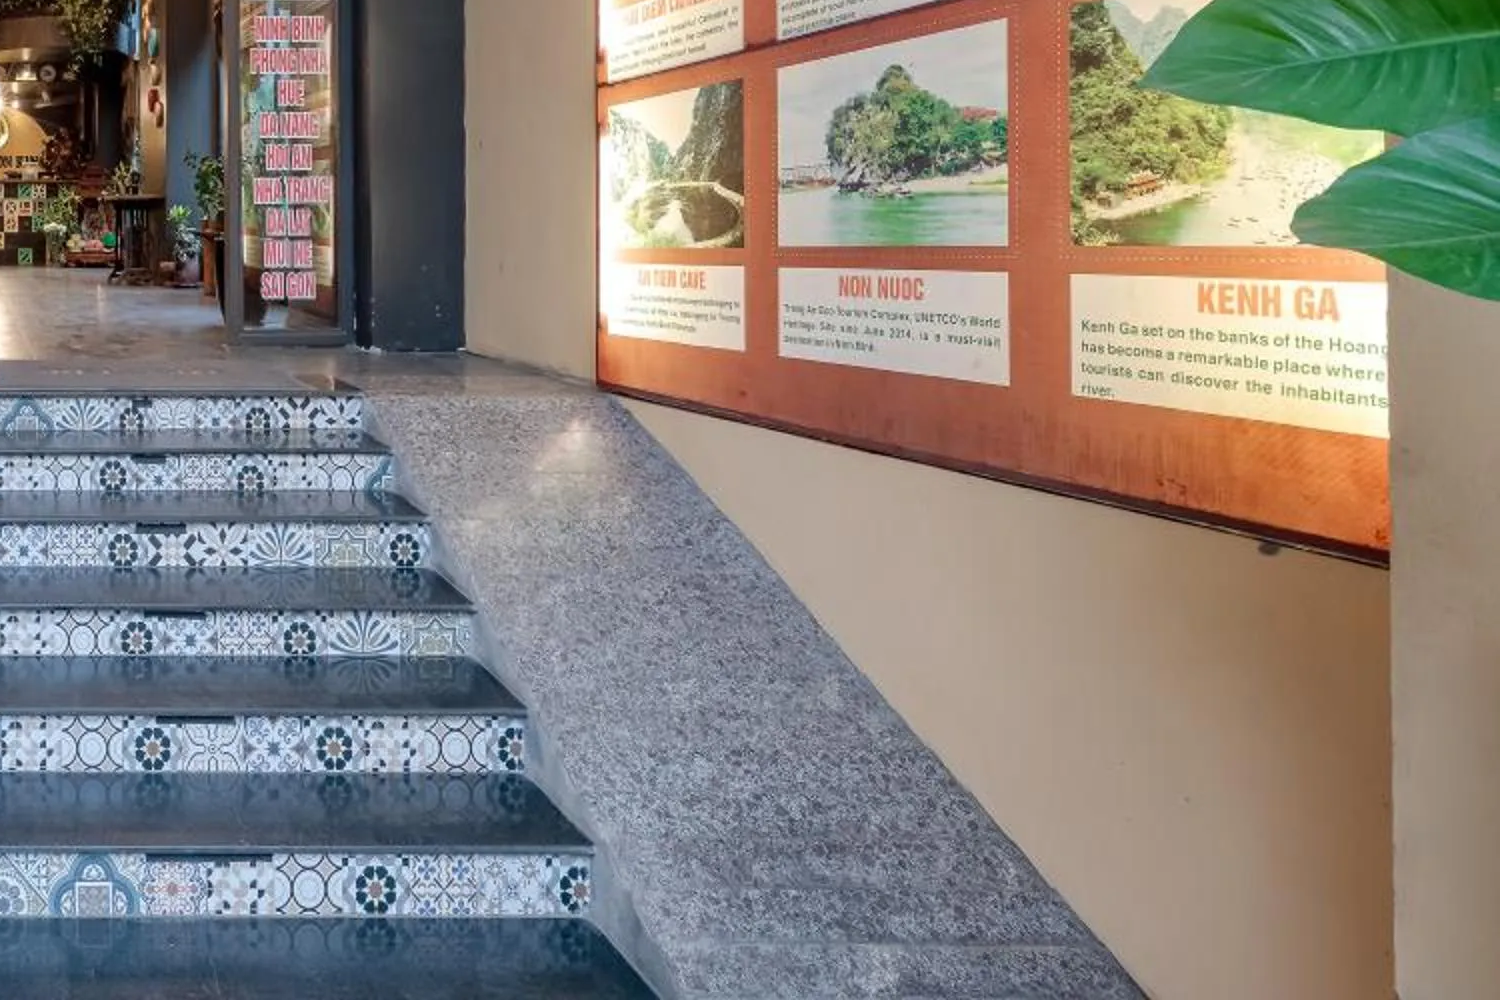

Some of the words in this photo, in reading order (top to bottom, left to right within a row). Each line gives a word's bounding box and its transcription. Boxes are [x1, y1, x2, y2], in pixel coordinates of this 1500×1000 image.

[255, 16, 290, 41] NINH
[292, 16, 324, 41] BINH
[251, 48, 296, 73] PHONG
[299, 48, 326, 73] NHA
[279, 80, 303, 106] HUE
[260, 112, 279, 137] DA
[281, 112, 320, 137] NANG
[291, 144, 312, 169] AN
[255, 178, 282, 203] NHA
[286, 177, 329, 202] TRANG
[266, 209, 285, 235] DA
[294, 240, 312, 267] NE
[261, 272, 284, 299] SAI
[286, 272, 316, 298] GON
[680, 270, 707, 289] CAVE
[839, 276, 871, 297] NON
[877, 276, 923, 300] NUOC
[1197, 283, 1280, 316] KENH
[1294, 286, 1339, 320] GA
[1081, 319, 1114, 333] Kenh
[1119, 321, 1138, 335] Ga
[1141, 326, 1163, 337] set
[1167, 328, 1185, 339] on
[1189, 327, 1214, 341] the
[1219, 330, 1268, 346] banks
[1273, 333, 1290, 348] of
[1294, 335, 1322, 350] the
[1081, 341, 1104, 354] has
[1107, 344, 1162, 359] become
[1166, 351, 1174, 361] a
[1178, 352, 1268, 369] remarkable
[1273, 359, 1321, 375] place
[1325, 364, 1384, 382] where
[1081, 362, 1132, 378] tourists
[1137, 369, 1164, 381] can
[1170, 371, 1238, 390] discover
[1245, 379, 1272, 395] the
[1280, 384, 1388, 408] inhabitants
[1081, 383, 1114, 398] river.
